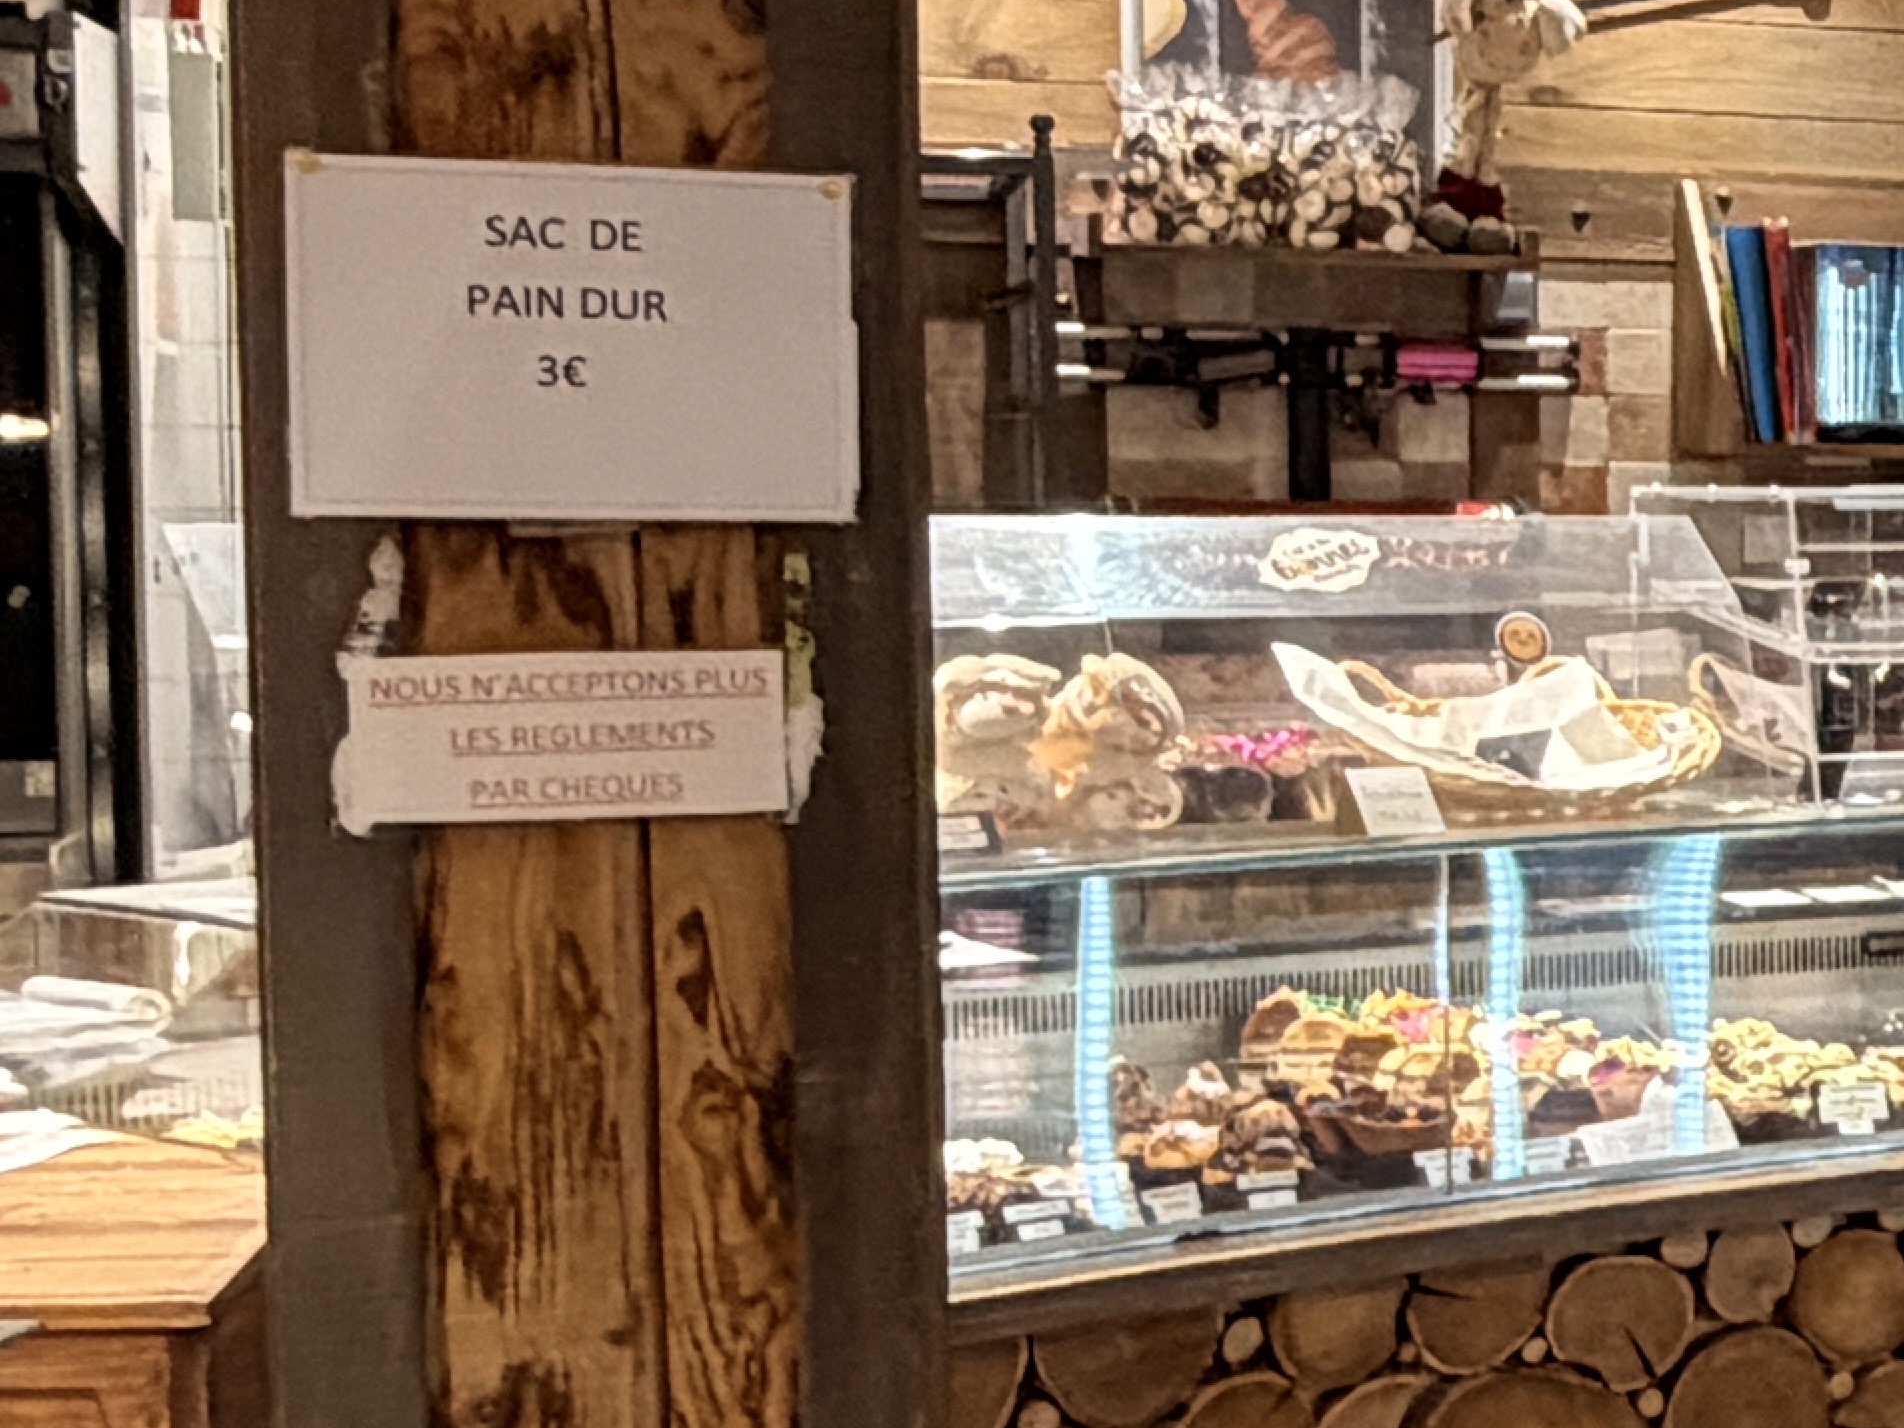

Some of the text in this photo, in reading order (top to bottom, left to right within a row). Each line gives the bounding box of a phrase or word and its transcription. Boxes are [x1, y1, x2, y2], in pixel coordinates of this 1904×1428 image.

[485, 214, 643, 252] SAC DE
[467, 283, 668, 323] PAIN DUR
[536, 354, 588, 388] 3€
[369, 667, 769, 701] NOUS N'ACCEPTONS PLUS
[450, 720, 716, 752] LES REGLEMENTS
[470, 773, 684, 805] PAR CHEQUES
